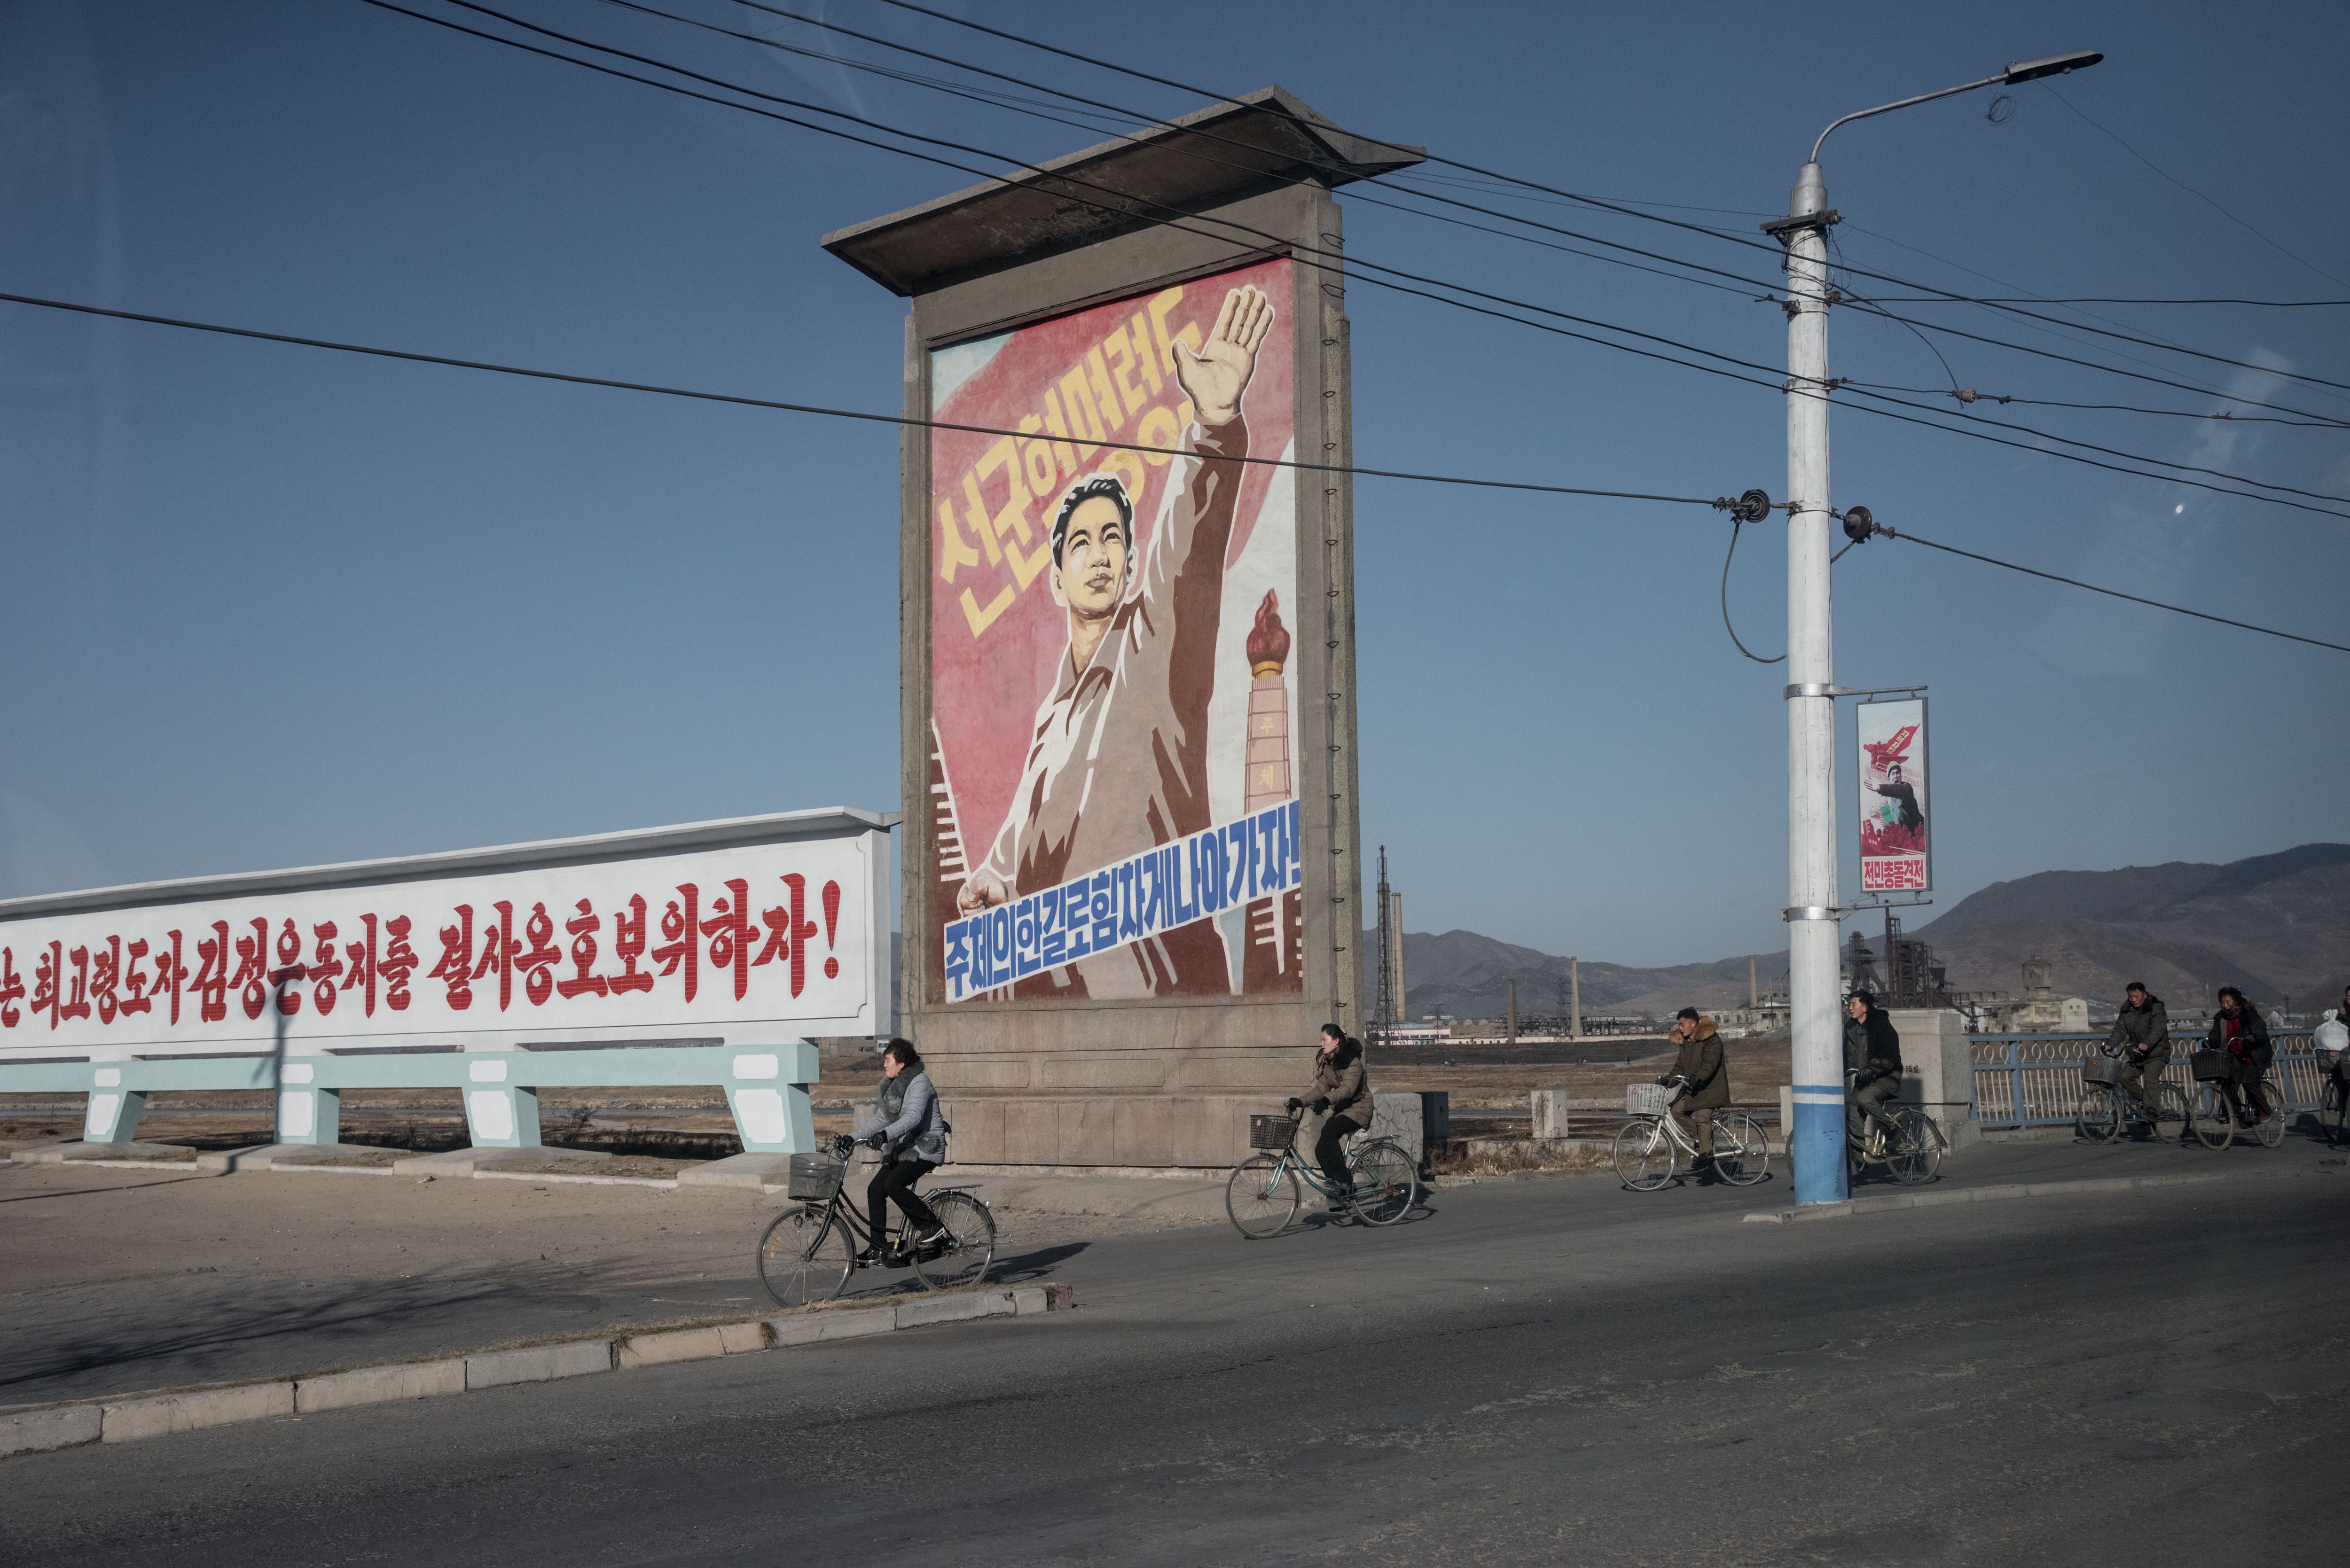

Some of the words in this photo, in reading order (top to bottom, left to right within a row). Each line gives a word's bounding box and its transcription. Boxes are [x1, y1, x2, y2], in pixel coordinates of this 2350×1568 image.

[1258, 717, 1275, 790] 주체
[1864, 859, 1924, 889] 전민총돌격전
[0, 946, 25, 1028] 는
